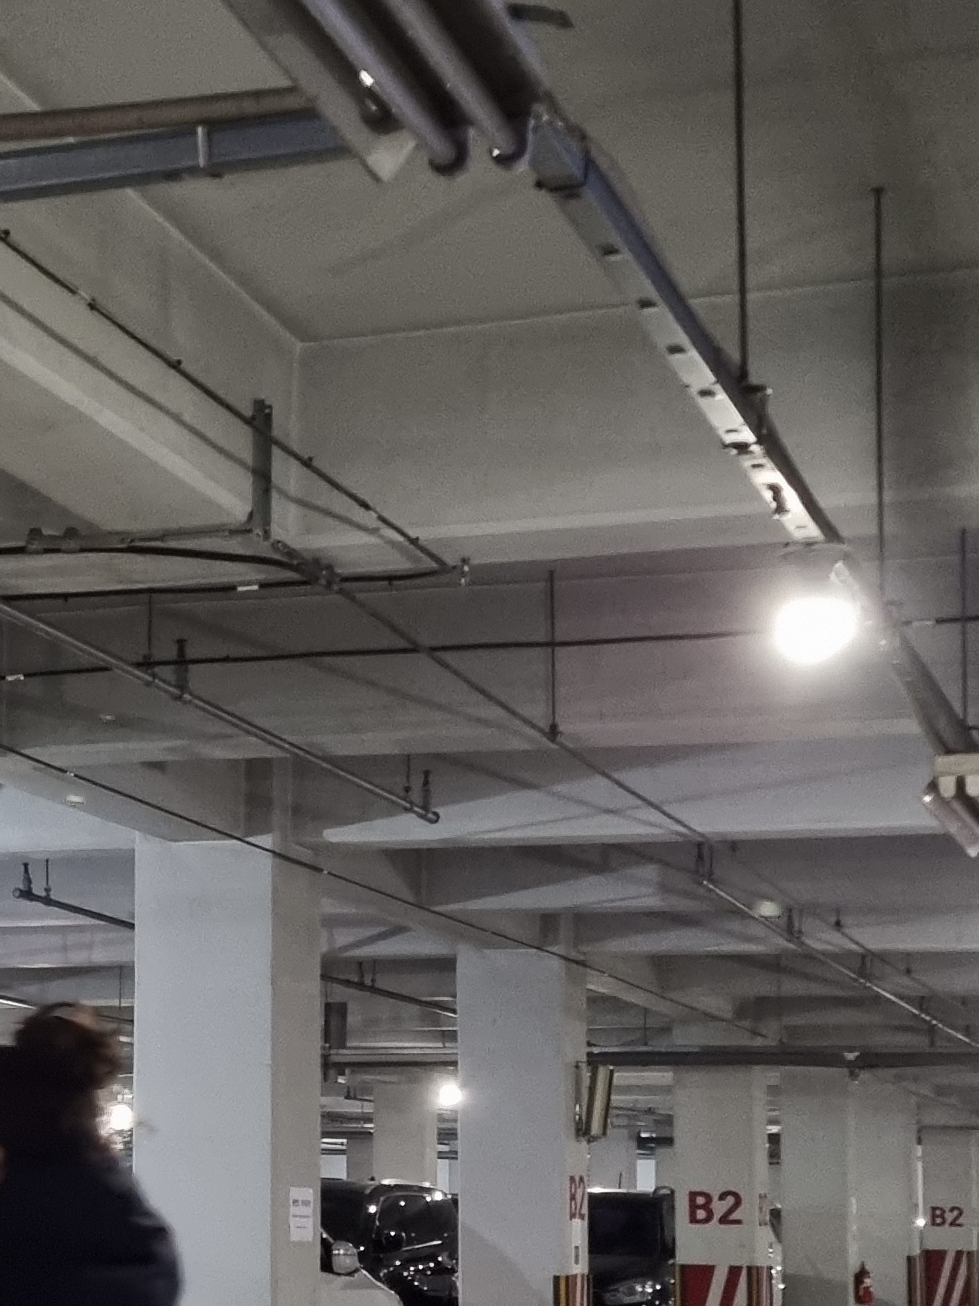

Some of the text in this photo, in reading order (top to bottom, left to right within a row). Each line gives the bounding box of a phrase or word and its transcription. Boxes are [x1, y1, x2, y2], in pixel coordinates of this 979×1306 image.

[569, 1175, 586, 1221] B2
[688, 1190, 743, 1225] B2
[930, 1205, 964, 1227] B2
